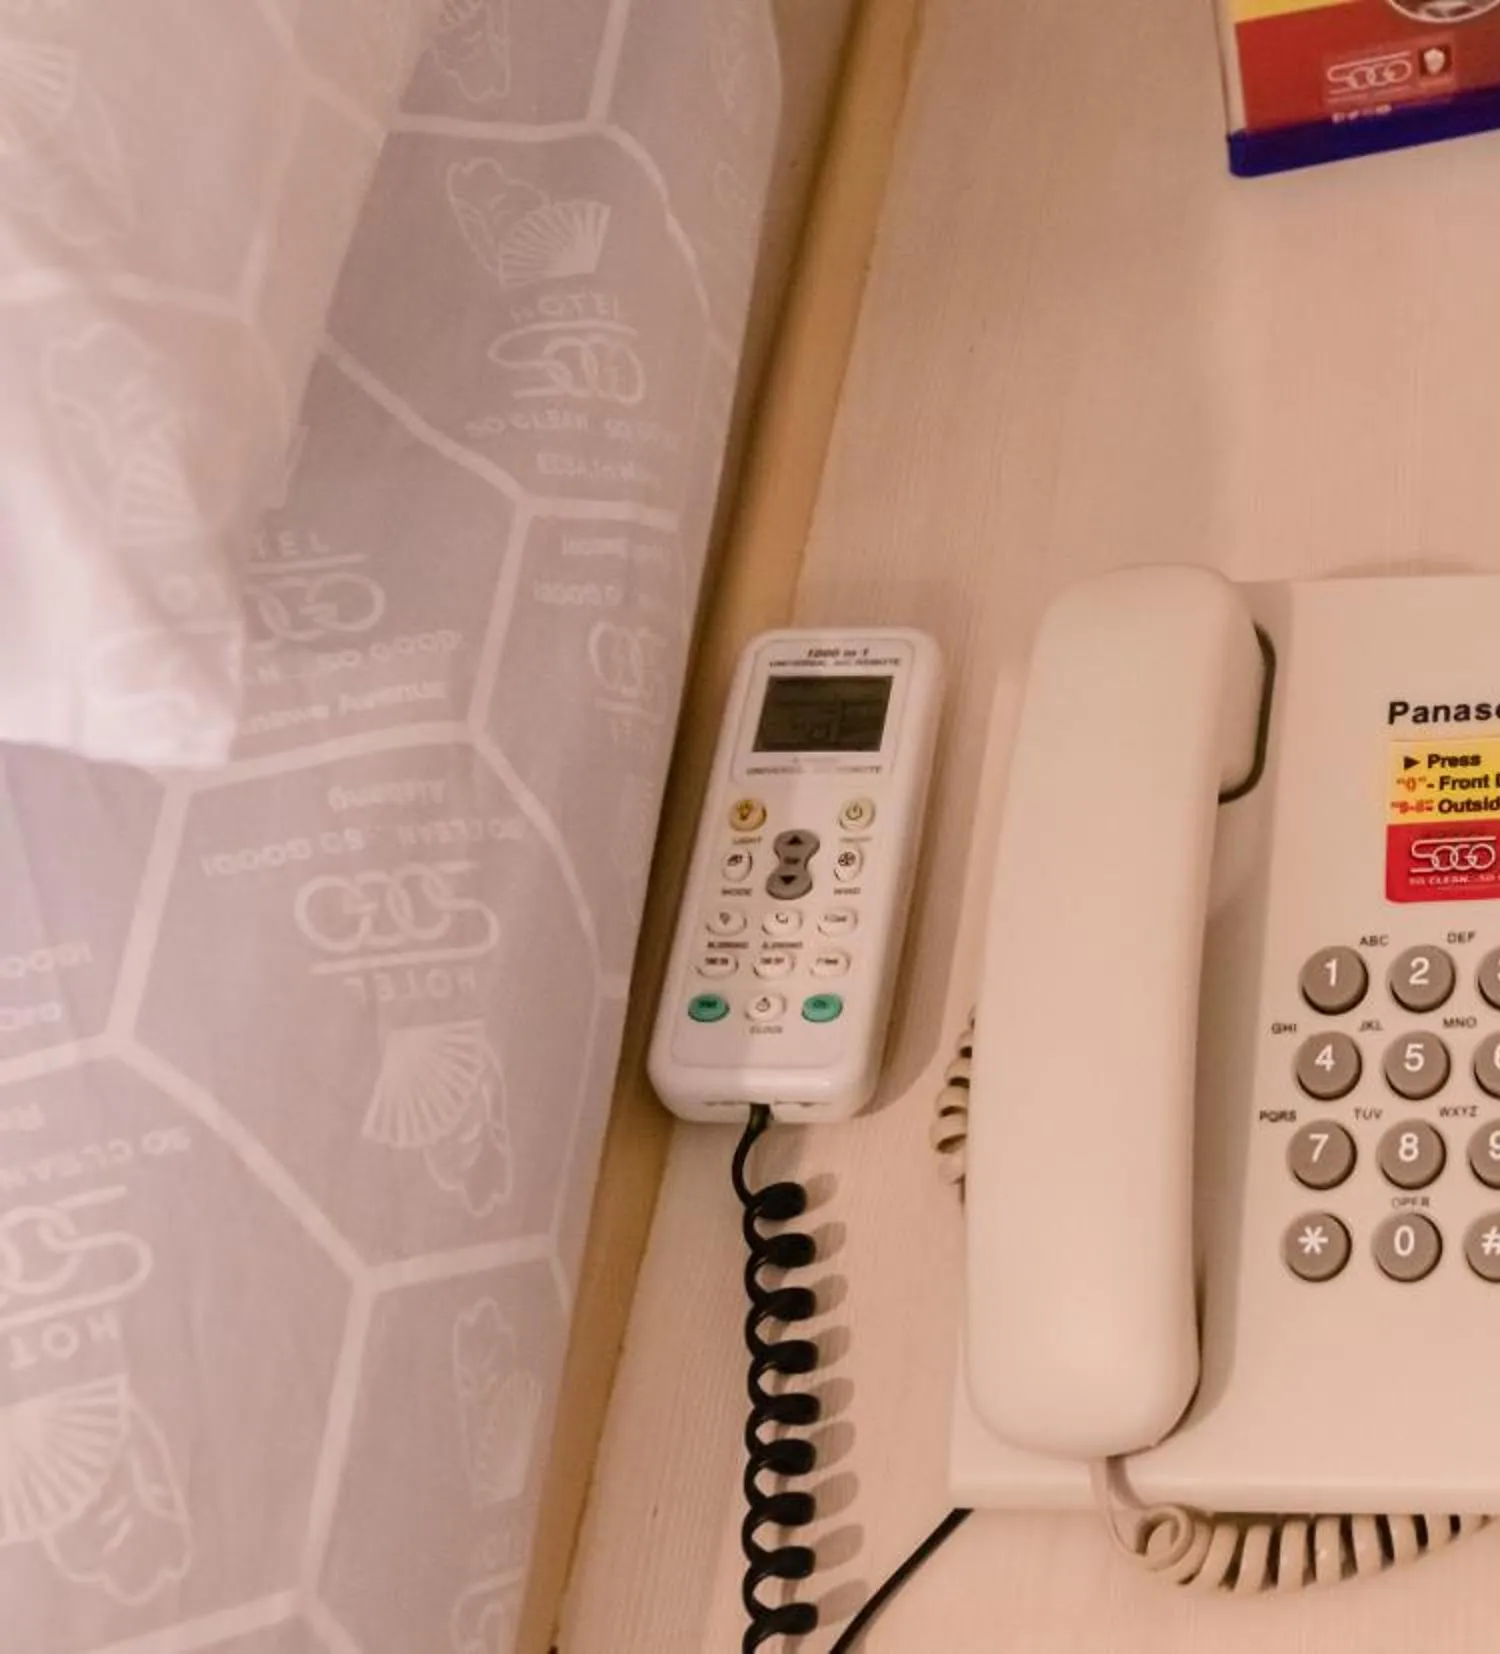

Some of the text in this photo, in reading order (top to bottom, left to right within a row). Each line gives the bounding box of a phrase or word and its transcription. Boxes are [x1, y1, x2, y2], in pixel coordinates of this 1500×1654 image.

[1427, 753, 1481, 769] Press
[1439, 773, 1489, 791] Front
[1409, 835, 1497, 873] SOGO
[1359, 934, 1390, 948] ABC
[1447, 931, 1476, 944] DEF
[1324, 958, 1339, 986] 1
[1409, 956, 1431, 985] 2
[1271, 1022, 1298, 1035] GHI
[1358, 1020, 1384, 1033] JKL
[1443, 1017, 1477, 1030] MNO
[1314, 1044, 1336, 1072] 4
[1403, 1042, 1425, 1072] 5
[1259, 1109, 1297, 1124] PQRS
[1353, 1107, 1384, 1121] TUV
[1439, 1105, 1478, 1118] WXYZ
[1308, 1133, 1329, 1163] 7
[1398, 1132, 1420, 1162] 8
[1393, 1227, 1415, 1257] 0
